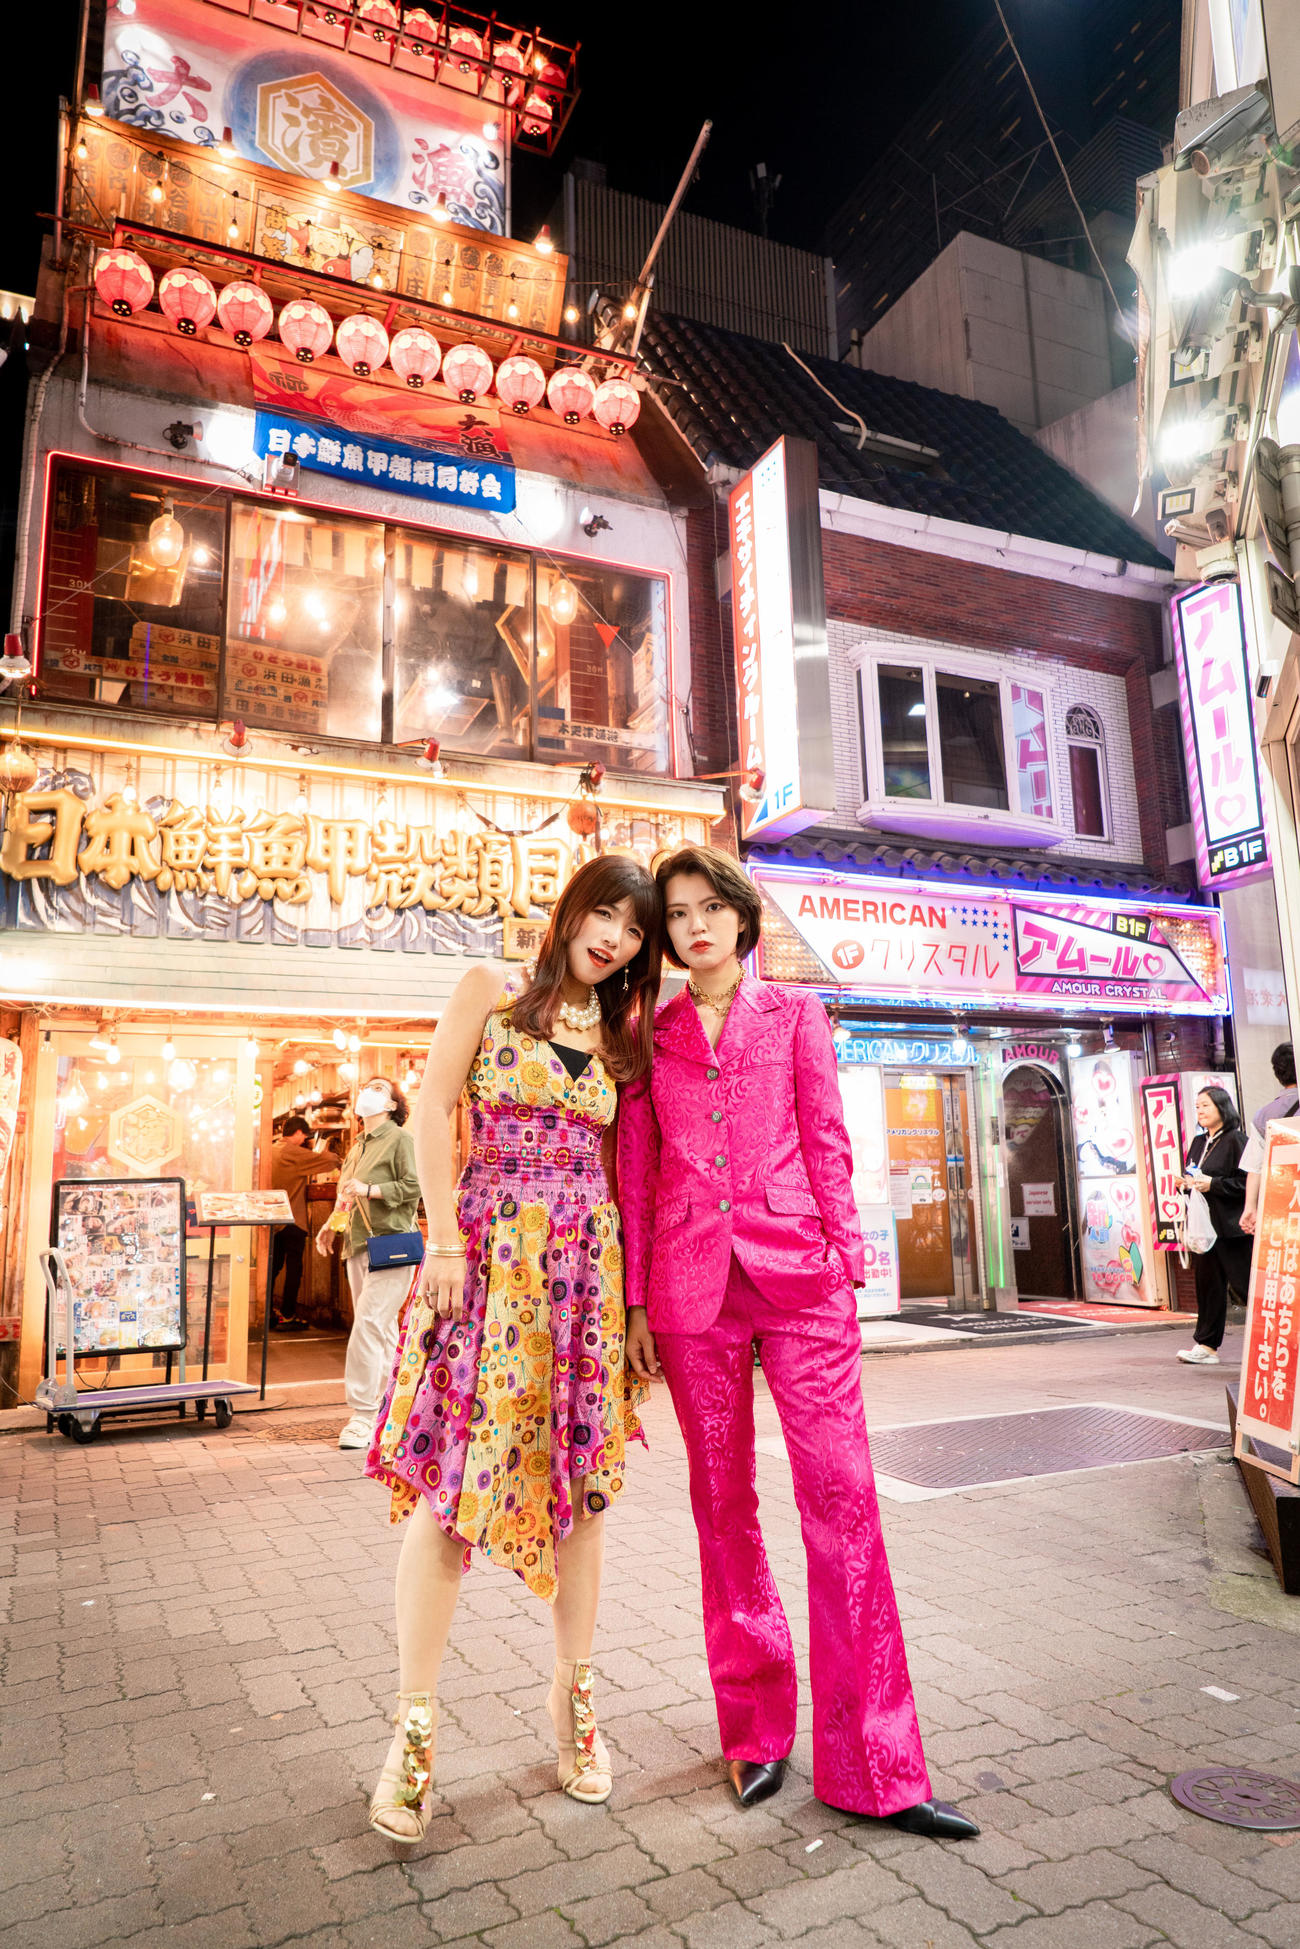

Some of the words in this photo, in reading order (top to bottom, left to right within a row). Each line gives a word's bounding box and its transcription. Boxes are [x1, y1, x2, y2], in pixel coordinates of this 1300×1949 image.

[145, 55, 212, 122] 大
[457, 413, 504, 460] 大漁
[268, 428, 503, 501] 日本鮮魚甲殻類同好会
[1184, 584, 1244, 788] アムール
[773, 782, 793, 810] 1F
[2, 789, 640, 917] 日本鮮魚甲殻類同
[1223, 839, 1263, 866] B1F
[798, 895, 947, 929] AMERICAN
[1115, 915, 1147, 938] B1F
[836, 943, 860, 967] 1F
[871, 938, 1000, 979] クリスタル
[1018, 920, 1142, 979] アムール
[1051, 981, 1101, 996] AMOUR
[1104, 984, 1168, 1000] CRYSTAL
[1003, 1043, 1060, 1065] AMOUR
[1147, 1088, 1179, 1197] アムール
[1254, 1217, 1286, 1419] ご利用下さい。
